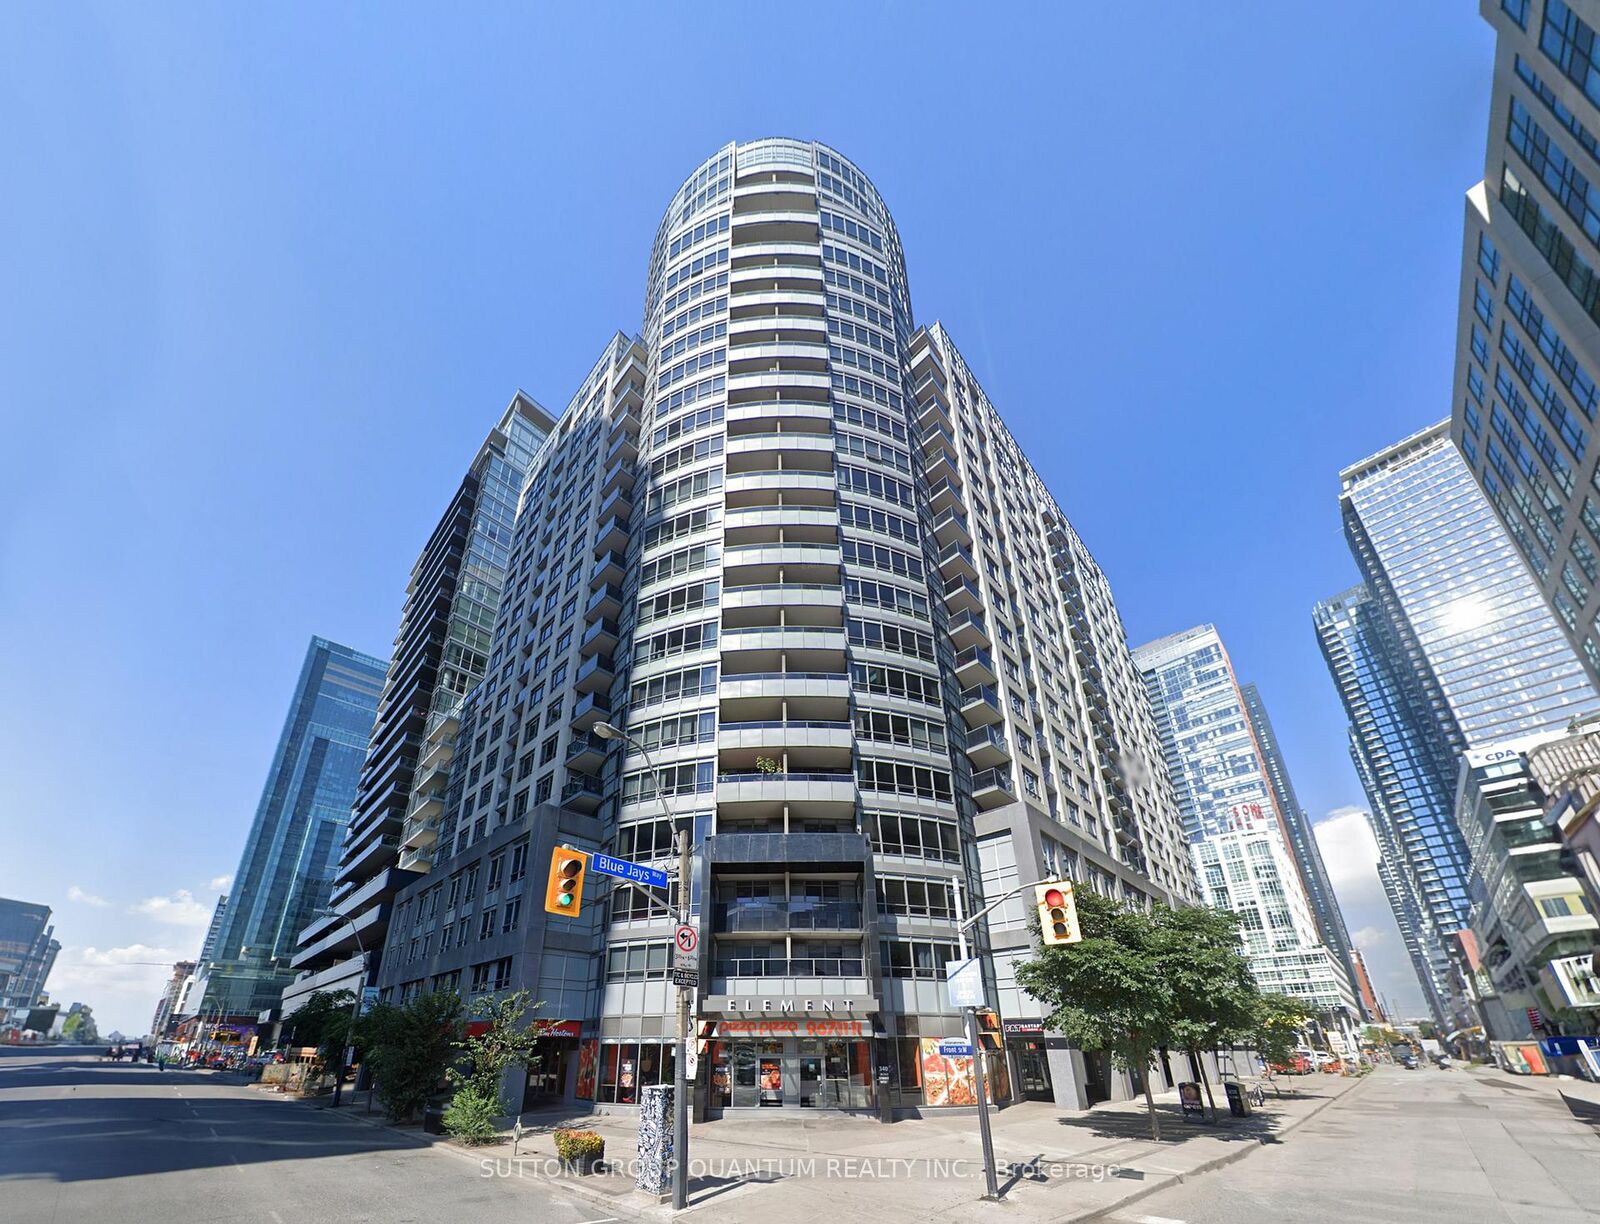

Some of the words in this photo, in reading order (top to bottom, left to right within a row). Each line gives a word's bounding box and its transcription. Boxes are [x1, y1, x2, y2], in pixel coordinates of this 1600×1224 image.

[1485, 749, 1516, 761] CPA
[599, 857, 625, 874] Blue
[627, 866, 650, 881] Jays
[652, 871, 662, 880] Way
[674, 978, 697, 986] EXCEPTED
[727, 999, 854, 1012] ELEMENT
[719, 1021, 757, 1036] pizza
[760, 1021, 799, 1036] pizza
